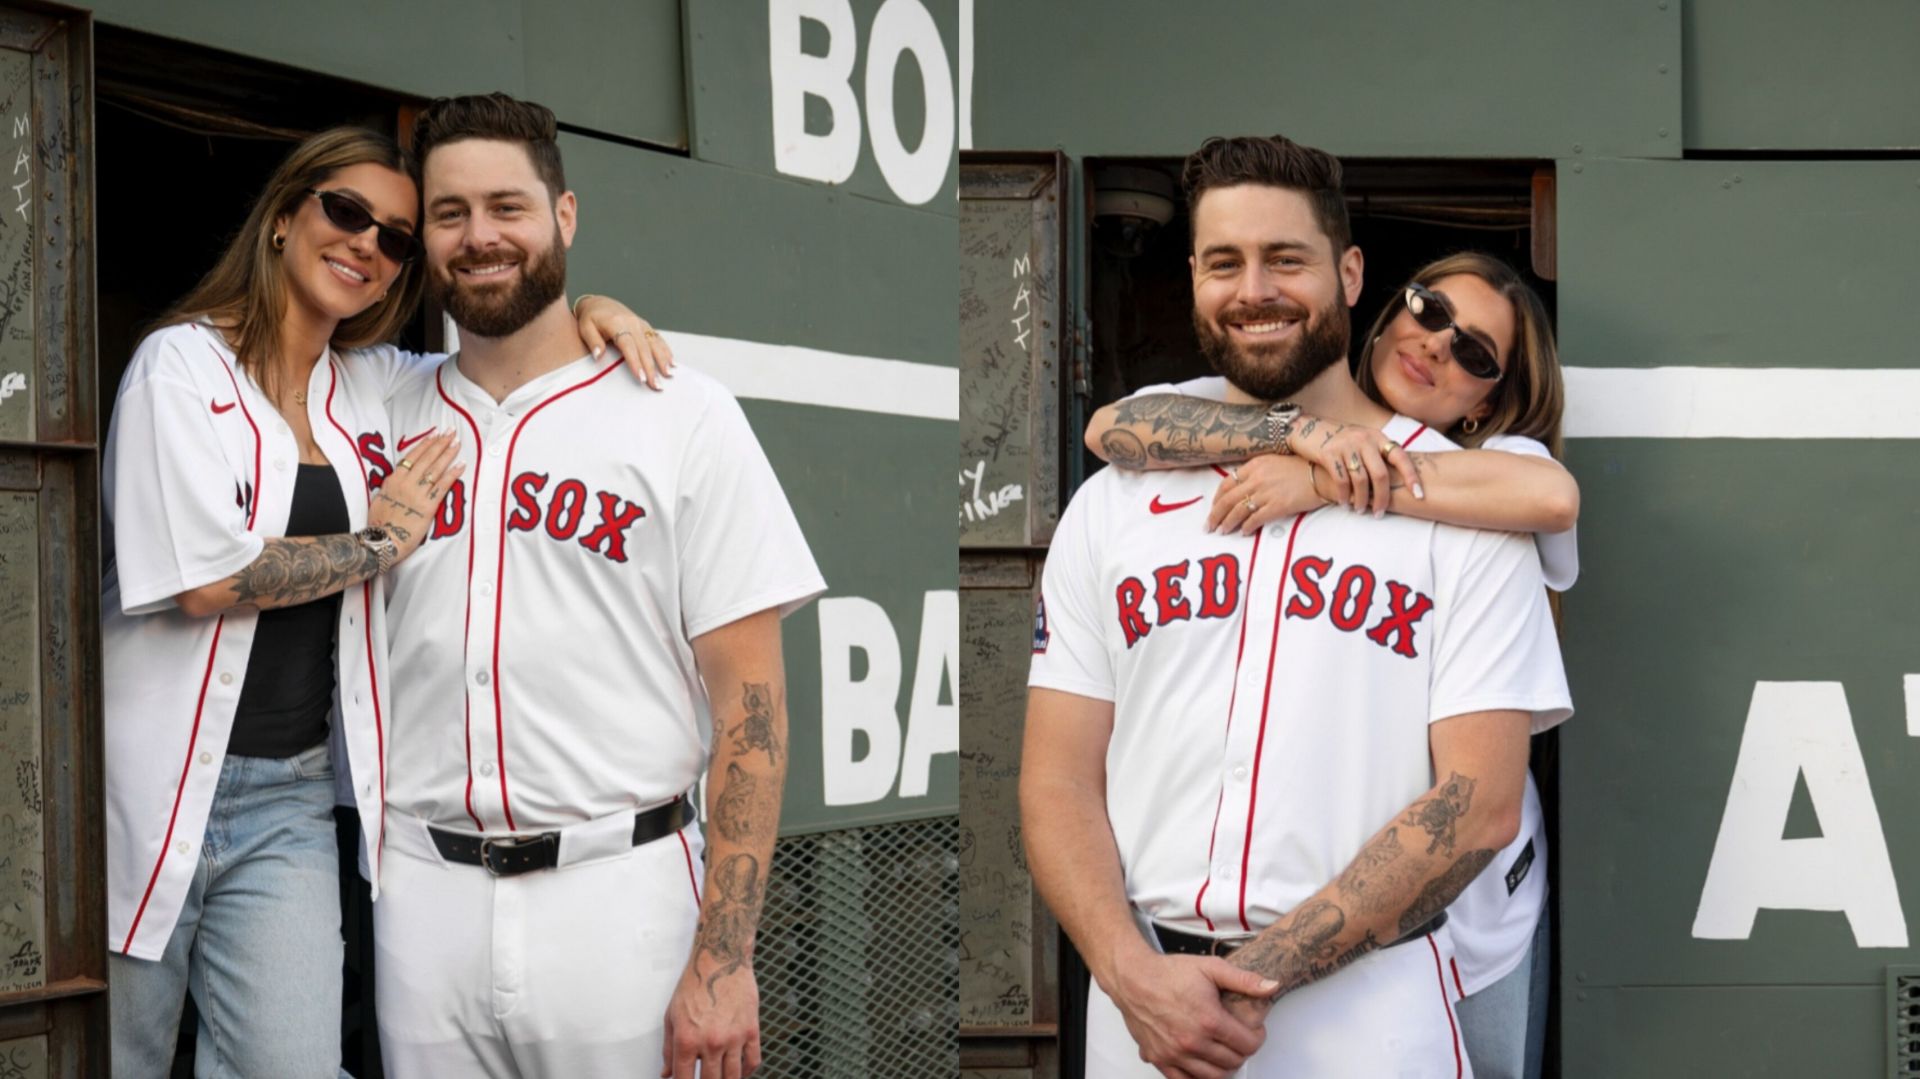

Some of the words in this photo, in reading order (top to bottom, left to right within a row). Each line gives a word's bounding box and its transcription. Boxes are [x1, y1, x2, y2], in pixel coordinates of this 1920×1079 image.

[769, 0, 958, 205] BO
[507, 471, 646, 563] SOX
[1116, 553, 1242, 649] RED
[1285, 556, 1434, 659] SOX
